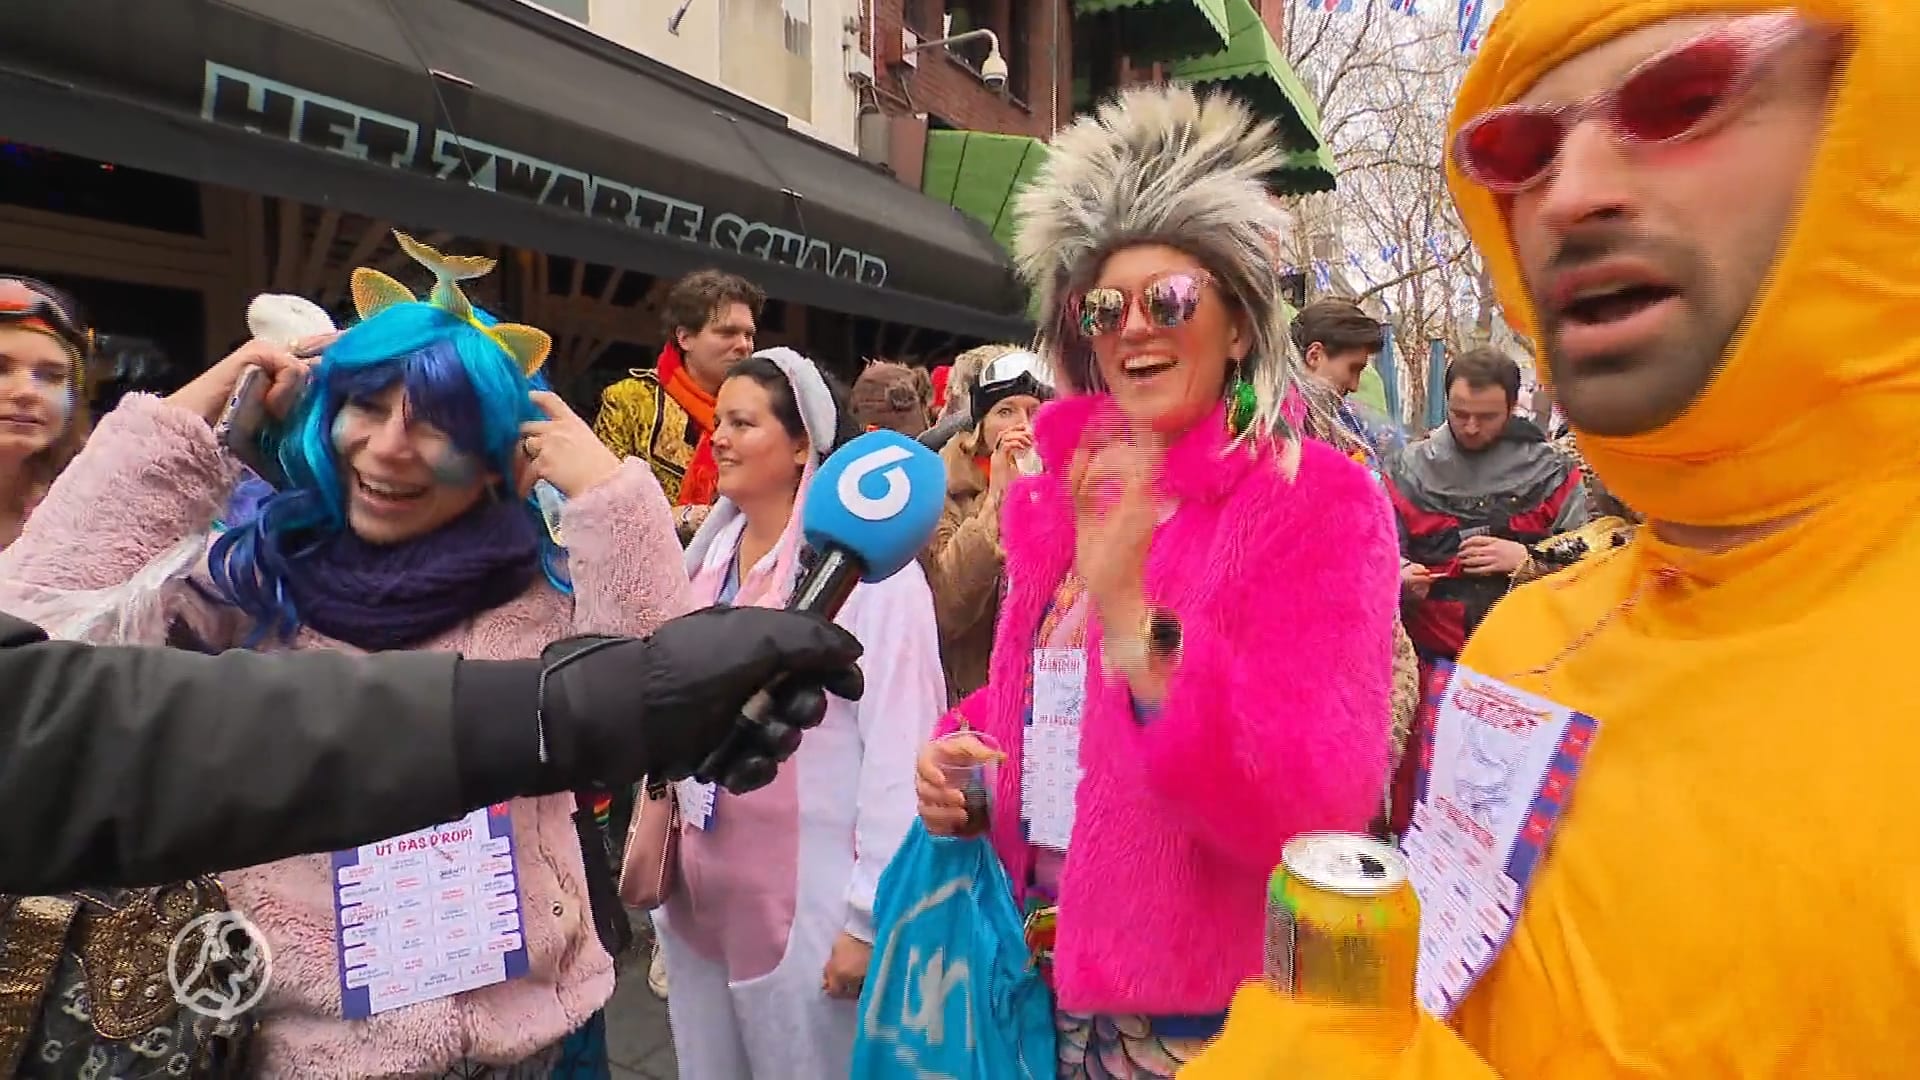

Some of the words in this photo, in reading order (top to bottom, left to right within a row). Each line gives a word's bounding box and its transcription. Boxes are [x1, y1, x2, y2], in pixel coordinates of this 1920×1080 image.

[201, 59, 419, 169] HET
[432, 128, 704, 243] ZWARTE
[710, 212, 888, 288] SCHAAP
[837, 444, 914, 521] 6
[375, 843, 392, 856] UT
[398, 837, 426, 852] GAS
